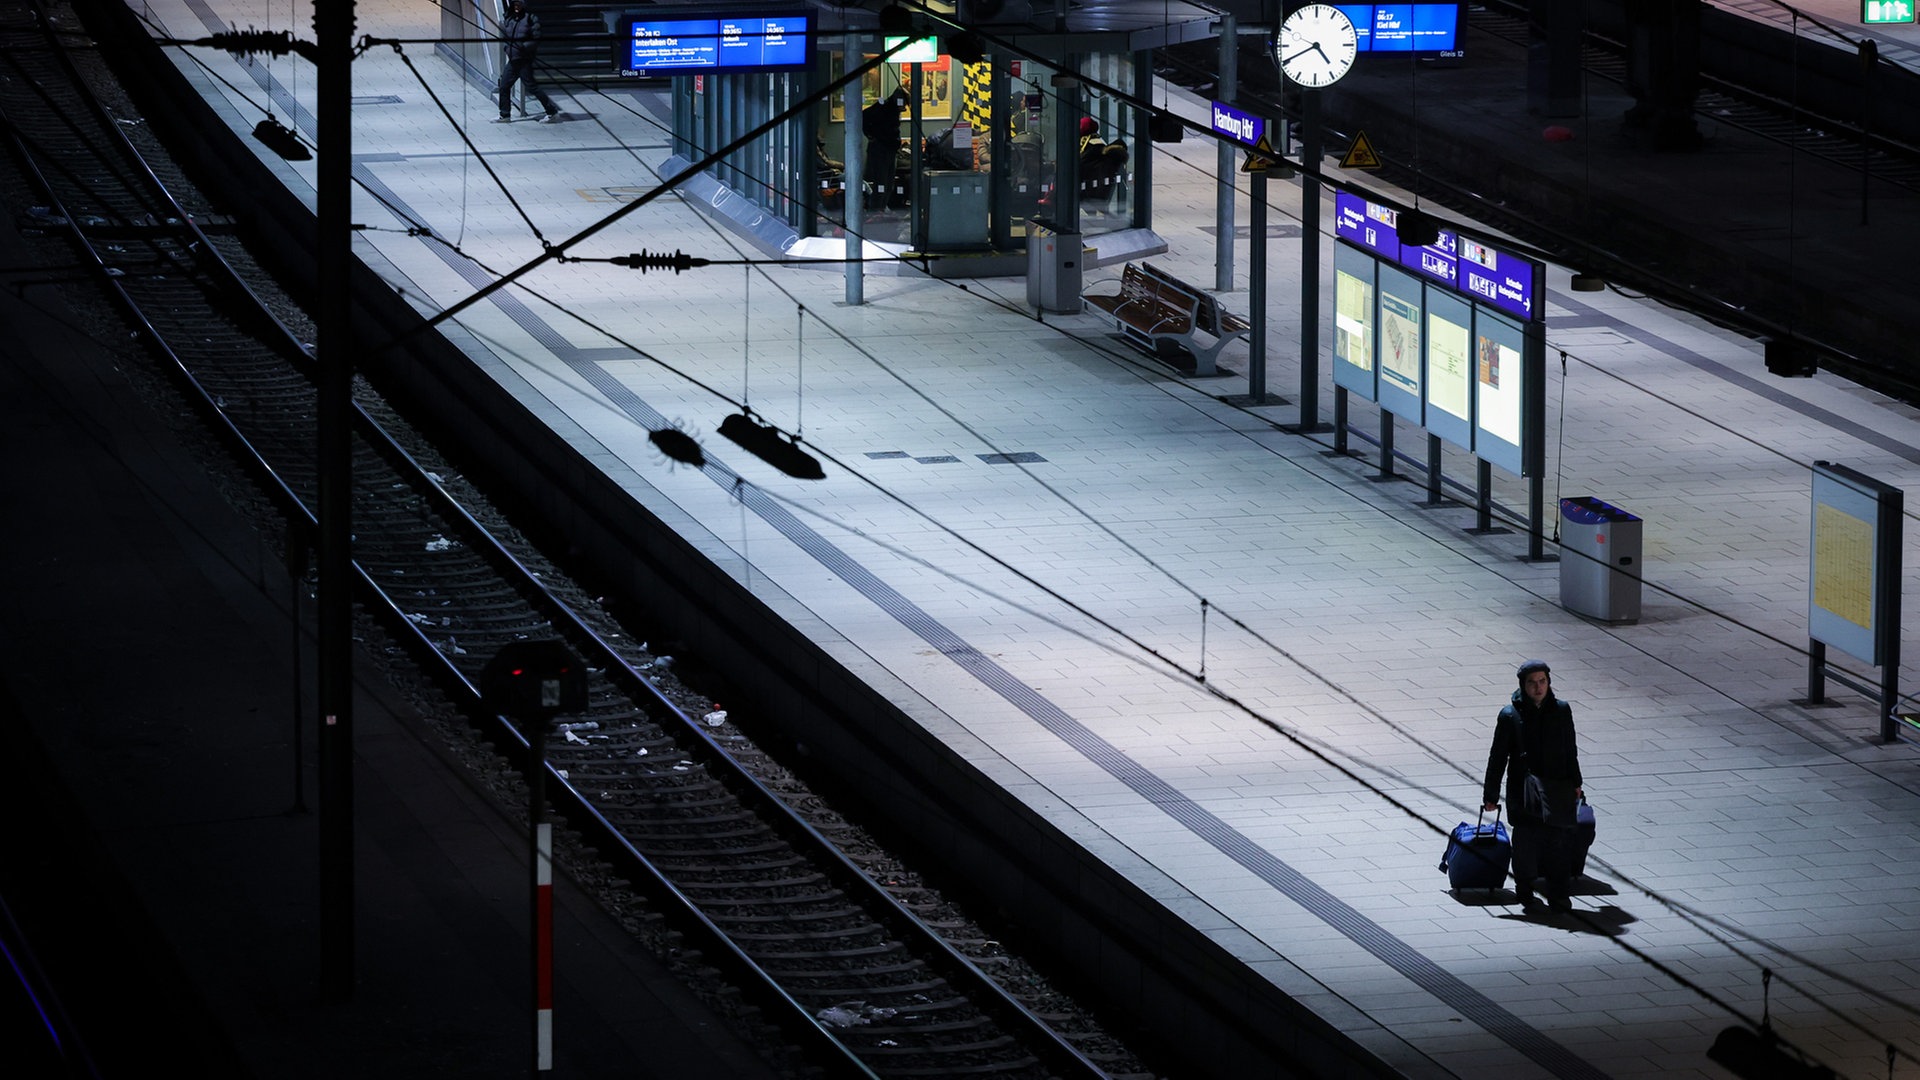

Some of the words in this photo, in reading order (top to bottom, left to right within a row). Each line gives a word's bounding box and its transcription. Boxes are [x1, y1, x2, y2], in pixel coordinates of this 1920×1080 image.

[666, 37, 678, 46] Ost
[1214, 107, 1242, 140] Hamburg
[1242, 118, 1254, 140] Hbf
